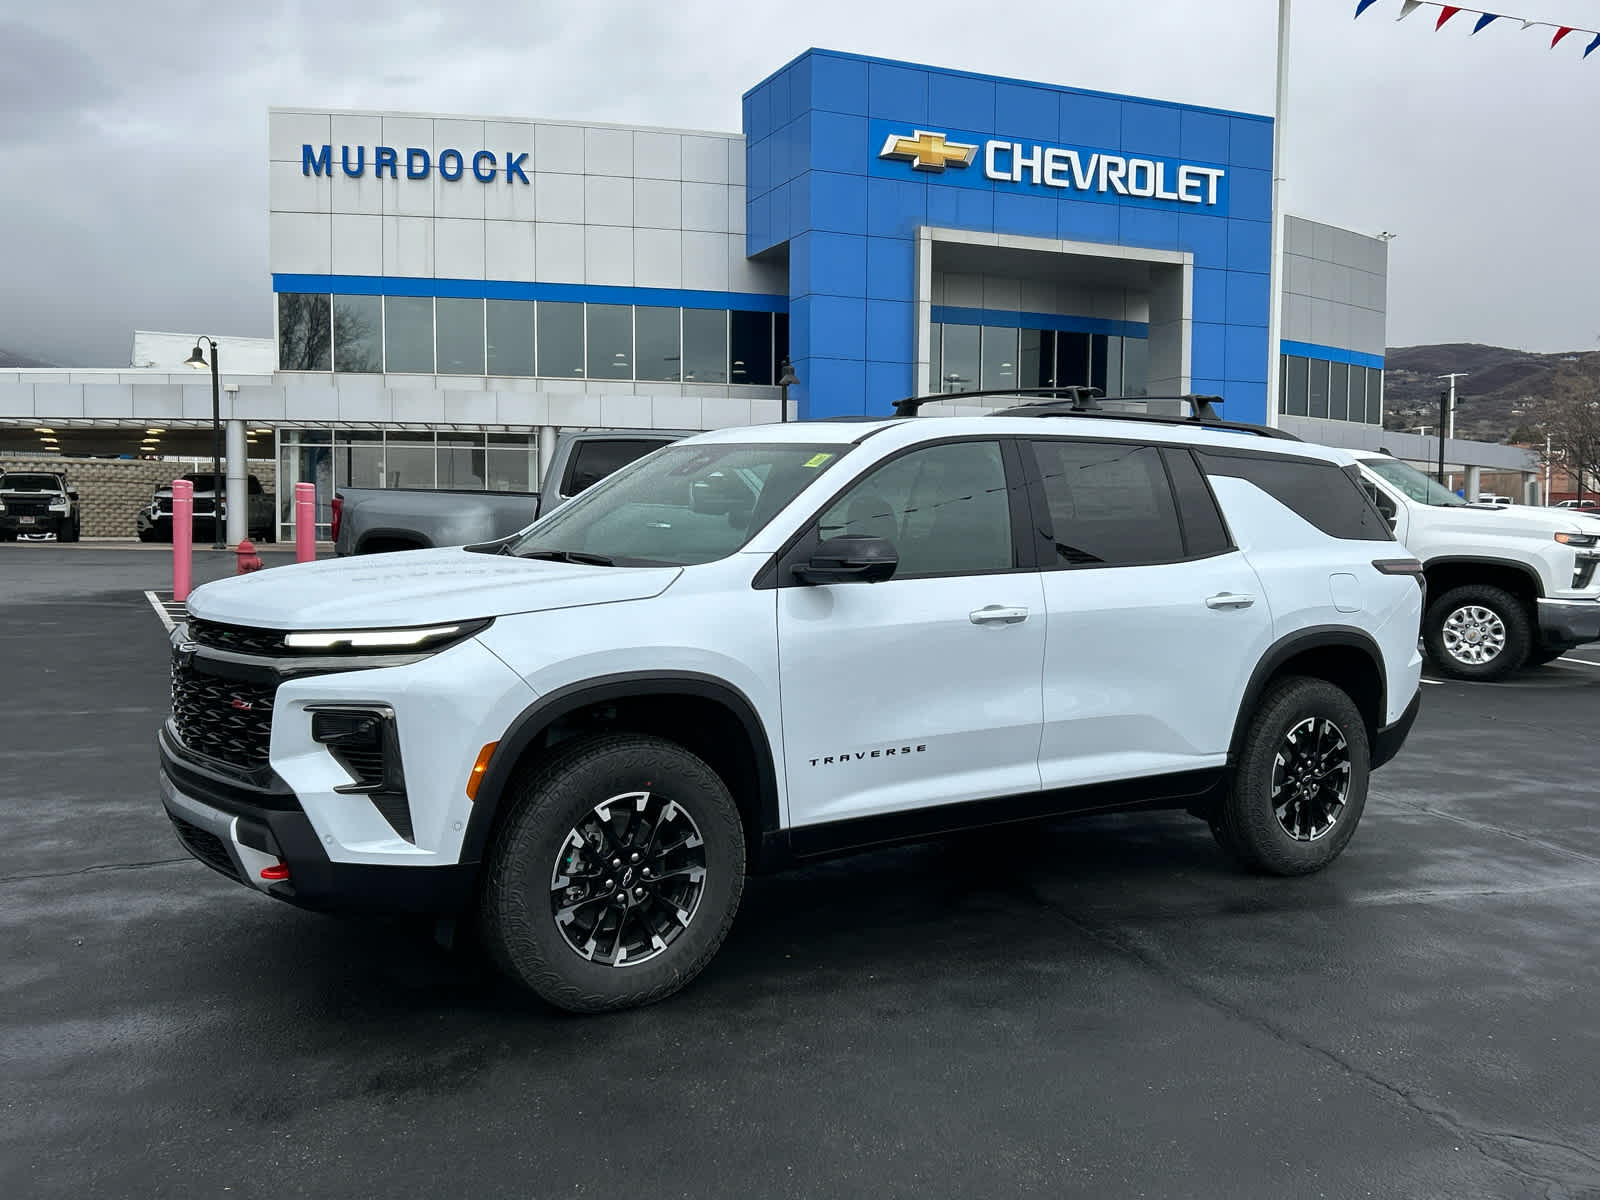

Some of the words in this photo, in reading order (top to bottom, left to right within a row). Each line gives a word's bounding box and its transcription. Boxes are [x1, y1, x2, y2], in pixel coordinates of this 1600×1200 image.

[302, 144, 529, 184] MURDOCK
[985, 139, 1225, 205] CHEVROLET
[808, 744, 927, 767] TRAVERSE
